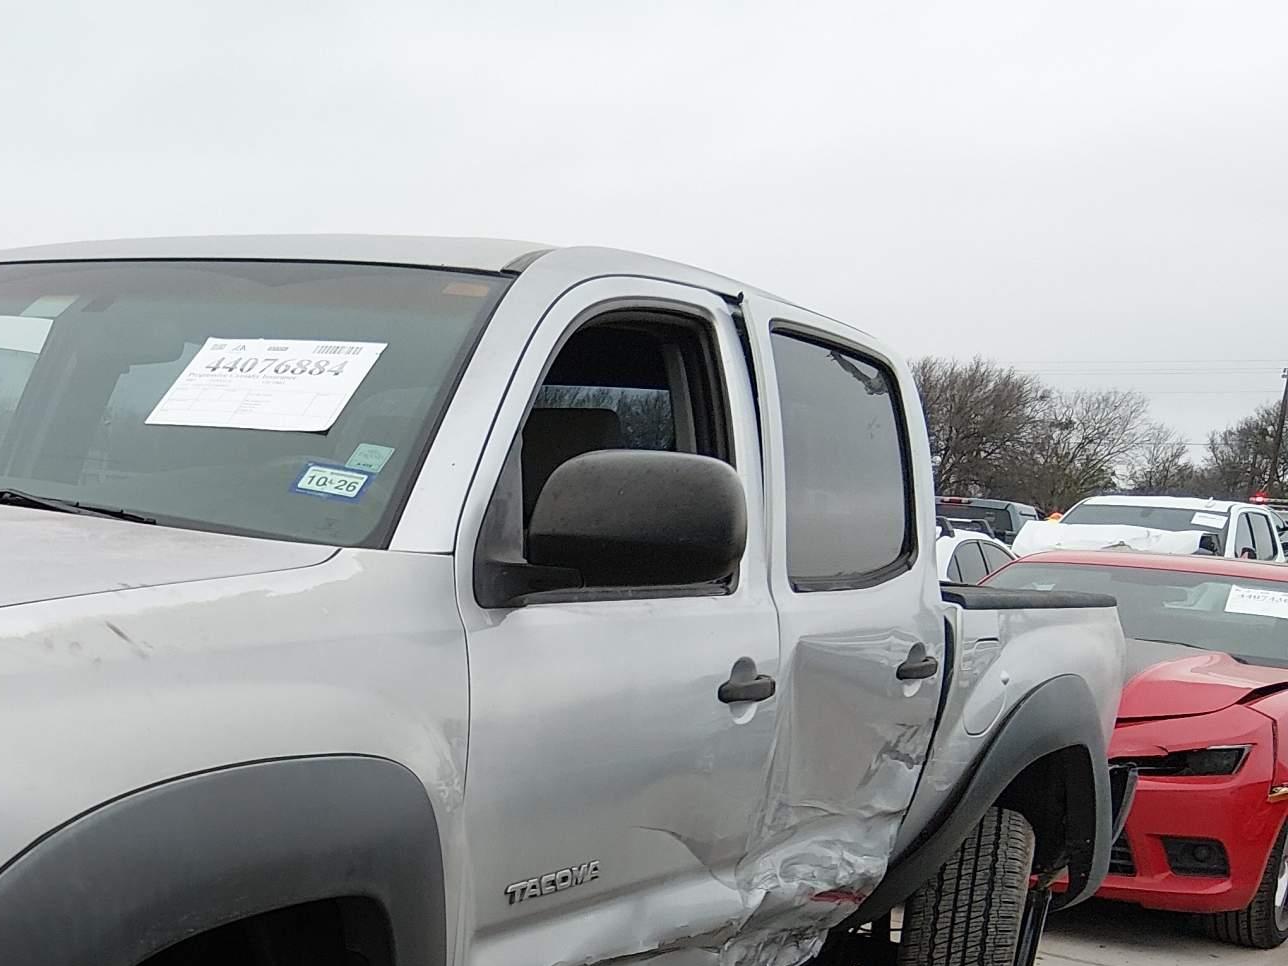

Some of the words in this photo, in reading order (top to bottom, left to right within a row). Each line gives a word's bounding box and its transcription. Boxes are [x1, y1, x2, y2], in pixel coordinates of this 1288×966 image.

[205, 357, 349, 377] 44076884
[334, 479, 360, 493] 26
[504, 860, 600, 904] TACOMA
